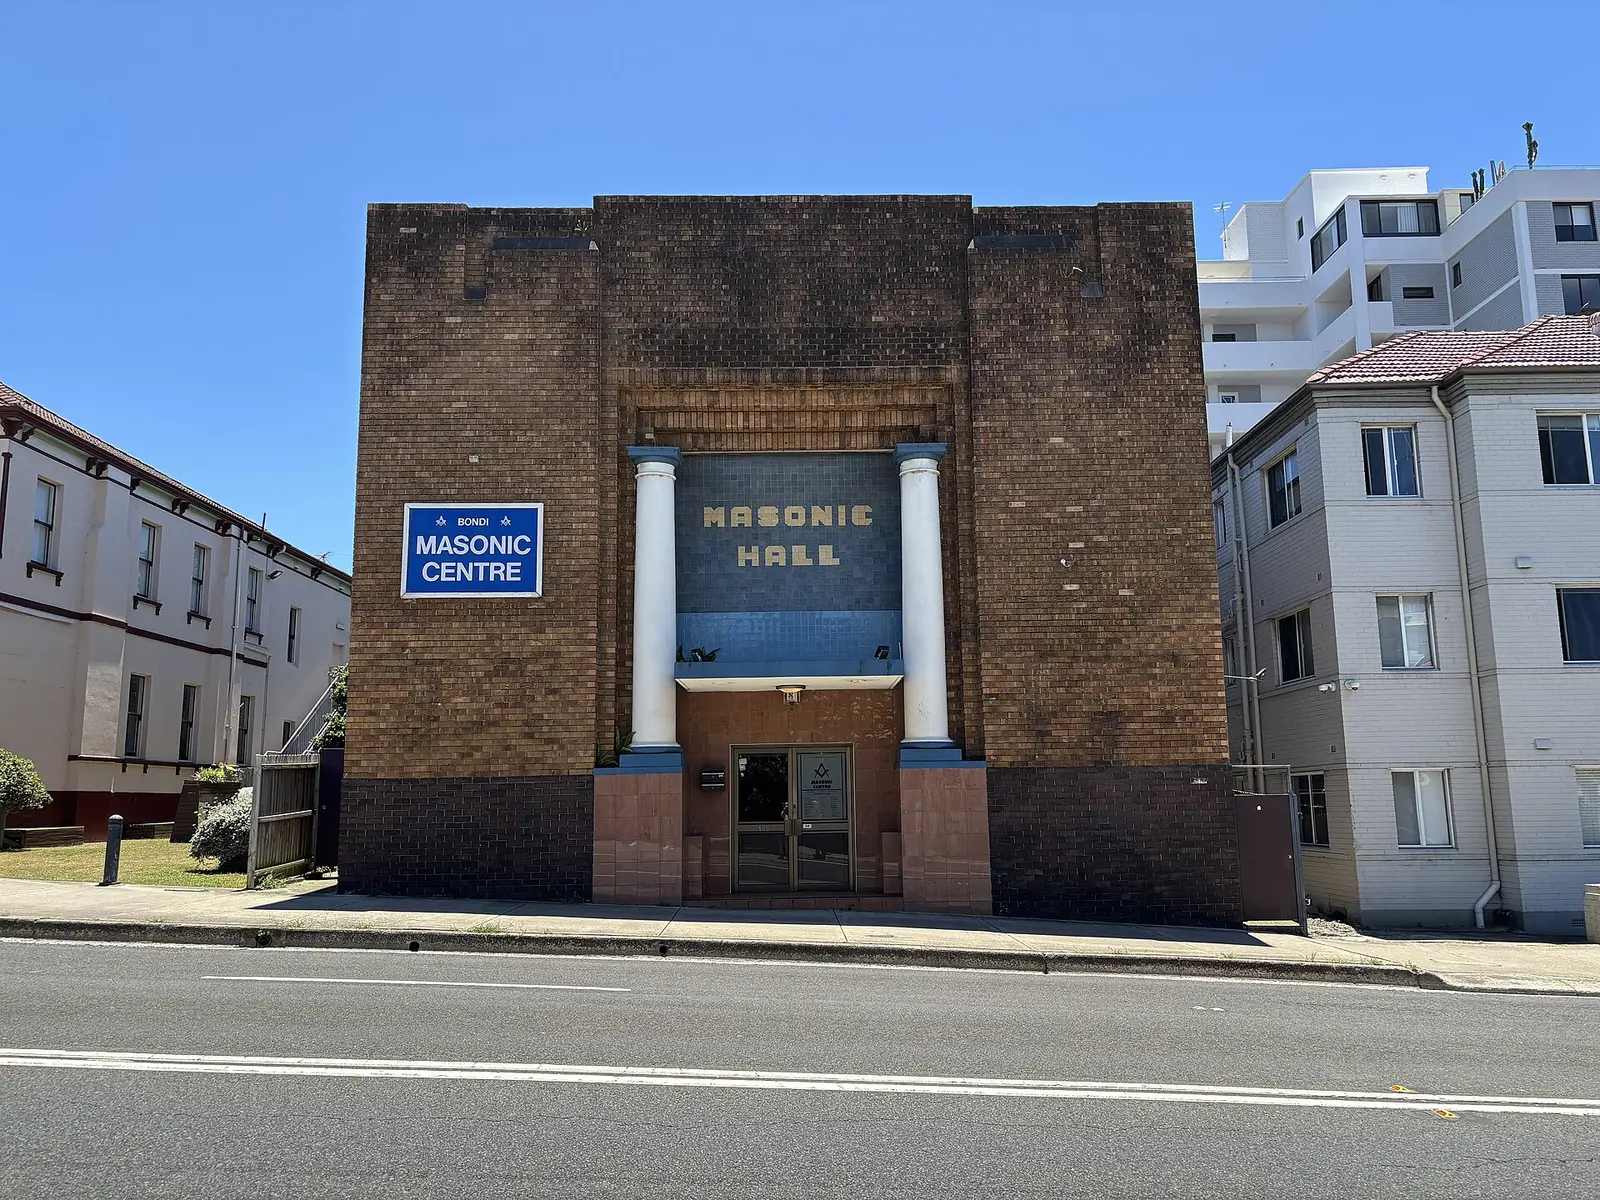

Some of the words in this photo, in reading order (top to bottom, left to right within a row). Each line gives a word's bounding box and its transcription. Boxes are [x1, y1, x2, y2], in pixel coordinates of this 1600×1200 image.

[458, 518, 488, 526] BONDI
[704, 505, 873, 527] MASONIC
[416, 535, 531, 555] MASONIC
[738, 545, 840, 566] HALL
[422, 562, 522, 582] CENTRE
